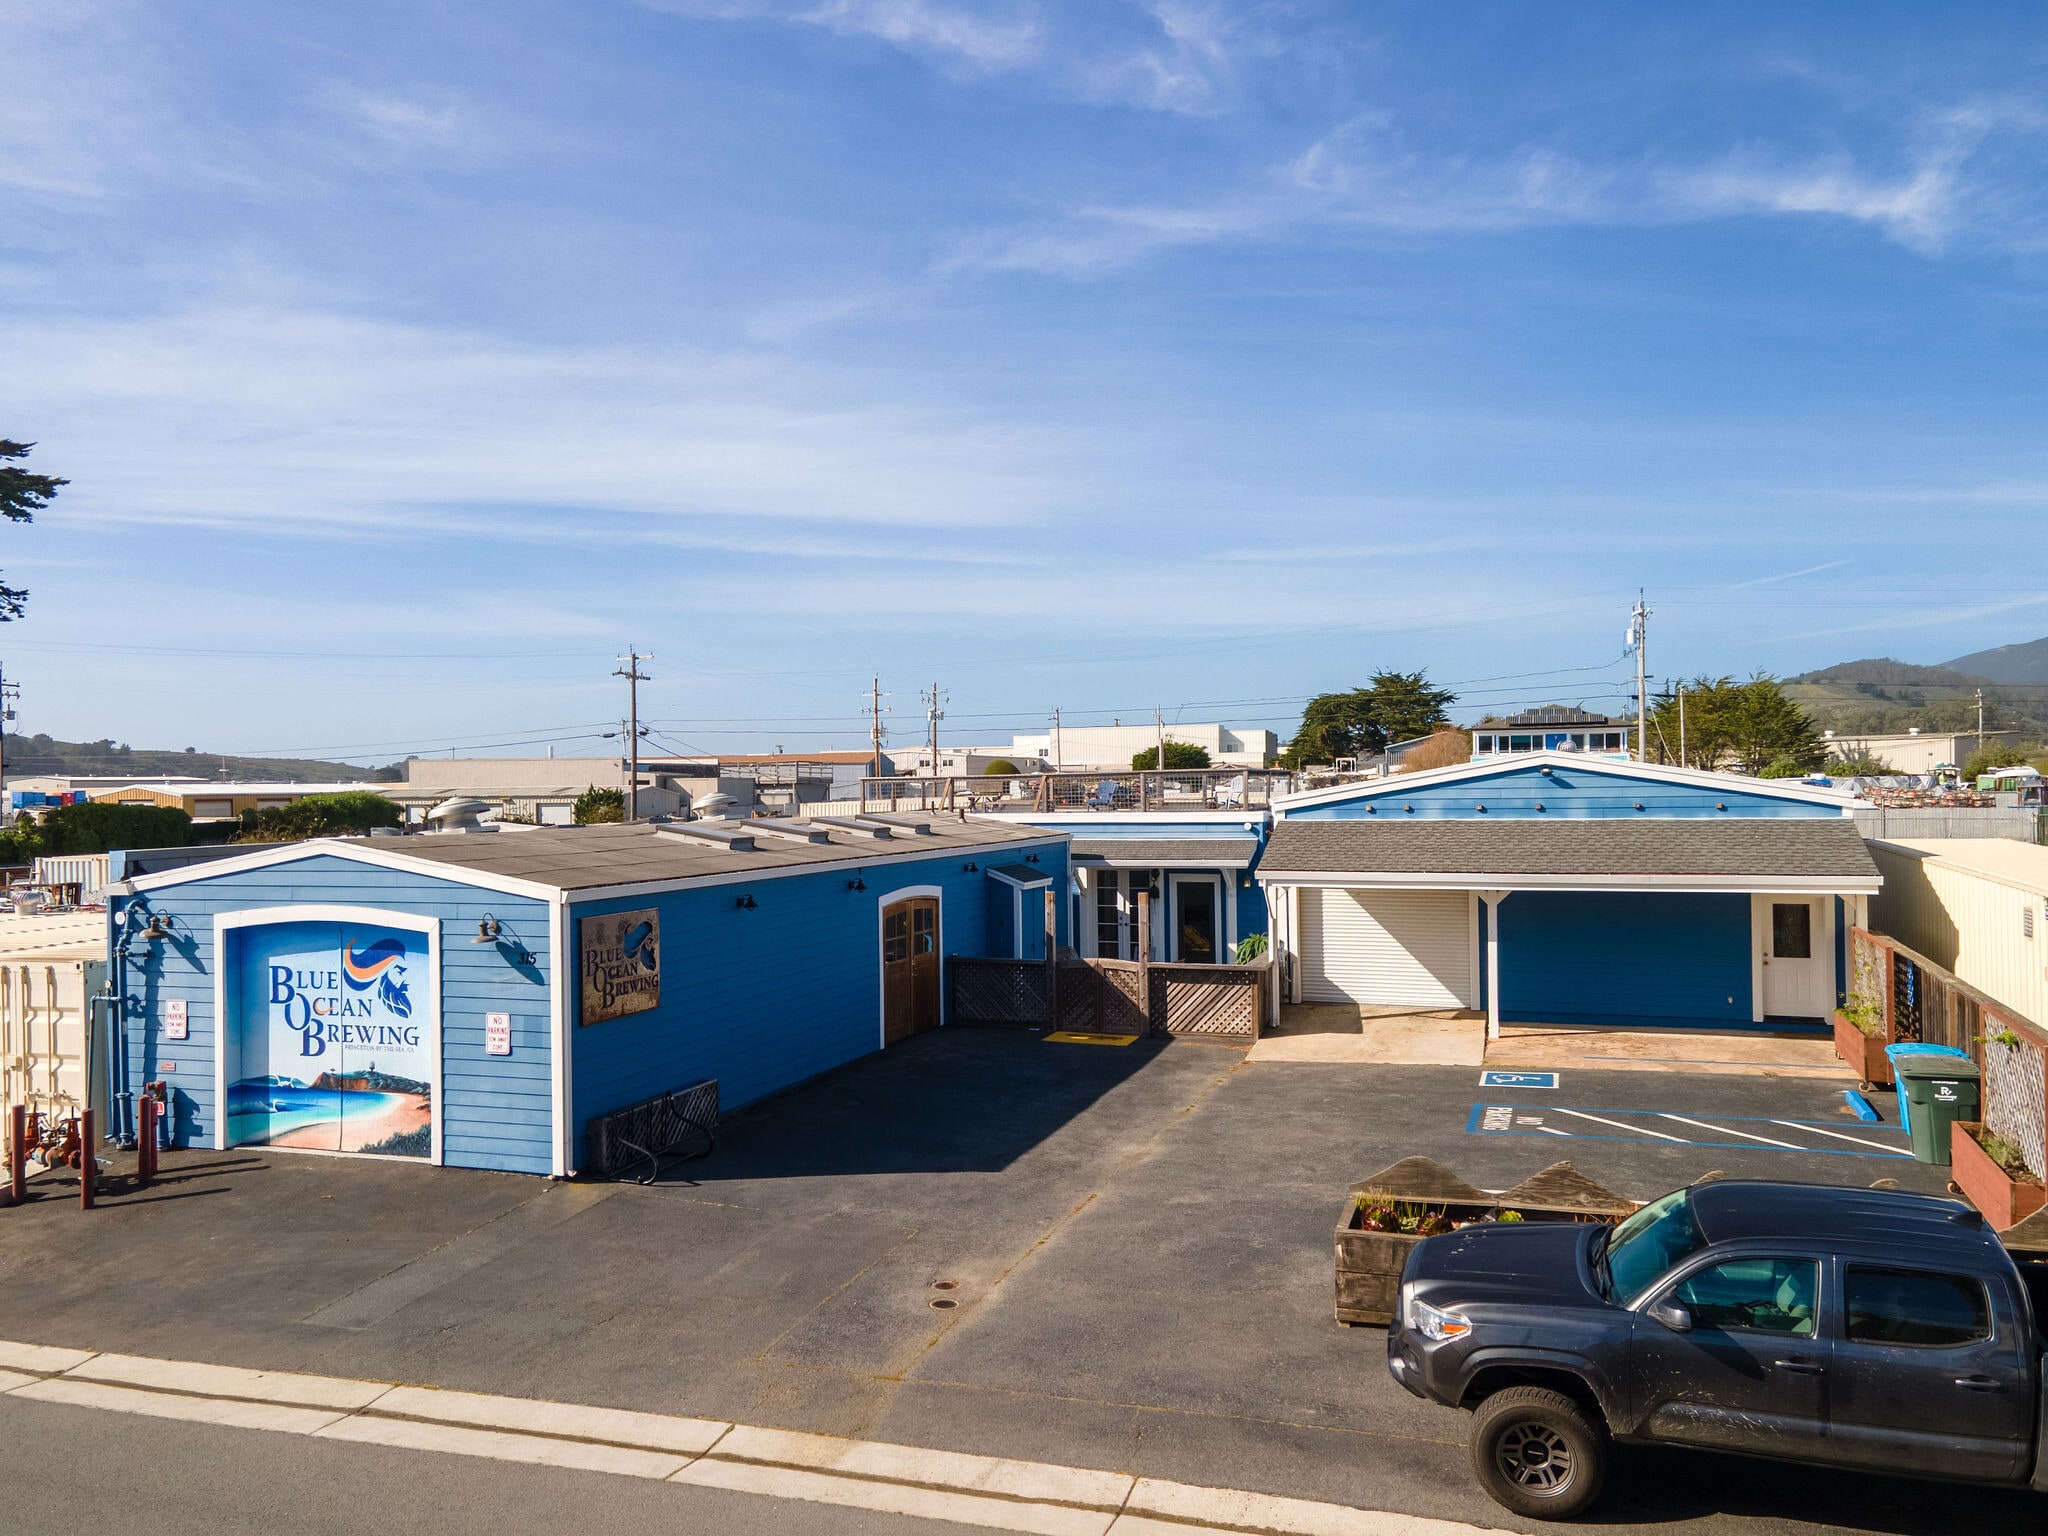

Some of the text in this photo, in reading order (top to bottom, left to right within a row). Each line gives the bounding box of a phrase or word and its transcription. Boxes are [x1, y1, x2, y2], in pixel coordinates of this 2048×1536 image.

[518, 952, 537, 965] 315
[585, 948, 622, 977] BLUE
[269, 965, 338, 1004] BLUE
[593, 962, 638, 993] OCEAN
[601, 974, 659, 1009] BREWING
[284, 993, 373, 1031] OCEAN
[493, 1016, 503, 1025] NO
[300, 1018, 420, 1057] BREWING
[1482, 1107, 1513, 1130] PARKING
